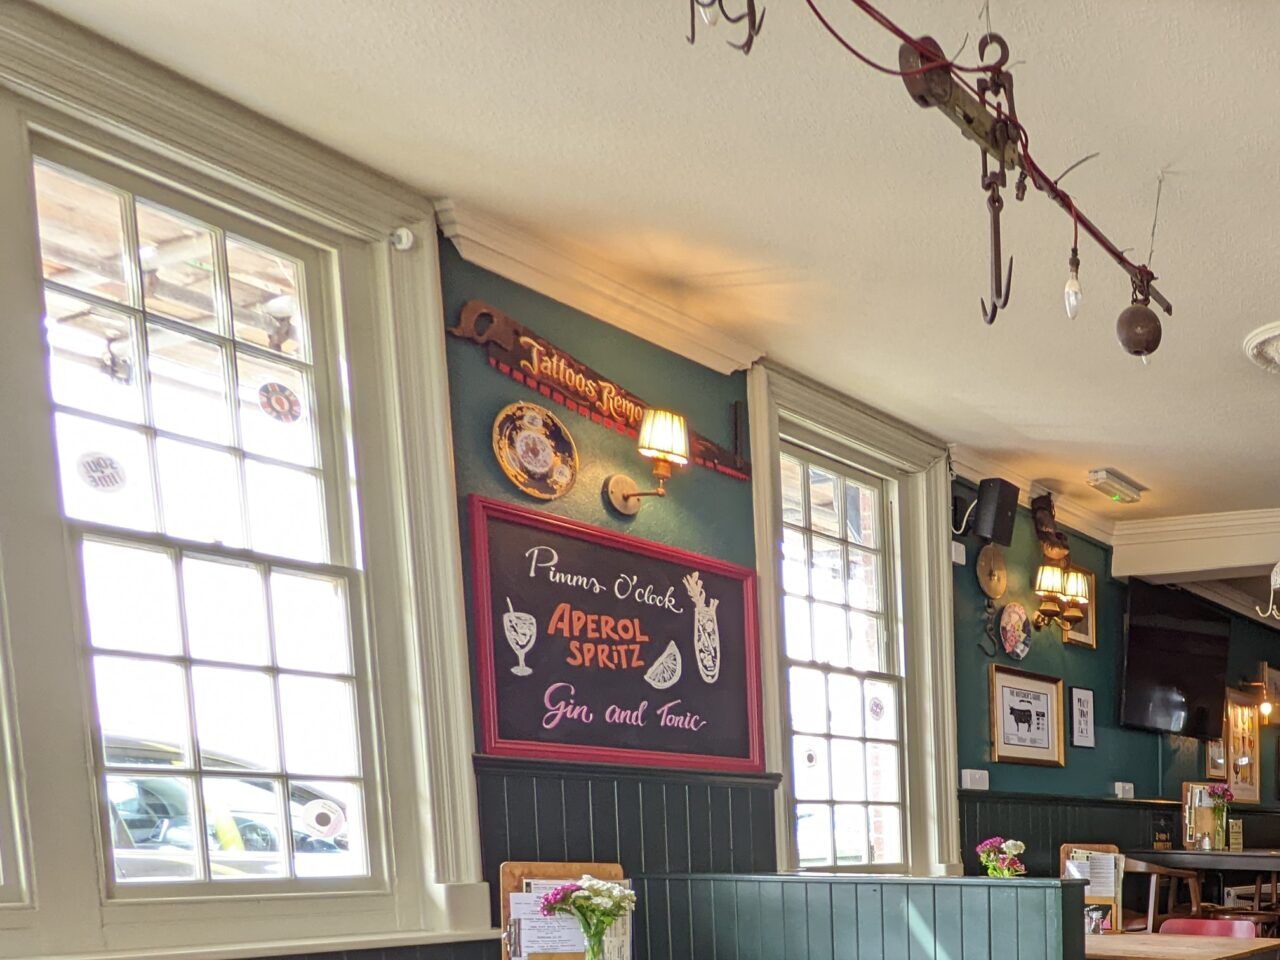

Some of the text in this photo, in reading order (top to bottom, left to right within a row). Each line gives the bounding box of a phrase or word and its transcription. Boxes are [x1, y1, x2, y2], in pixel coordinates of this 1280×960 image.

[519, 336, 644, 426] Tattoos Remo
[525, 545, 684, 614] Pimms O'clock
[547, 602, 650, 642] APEROL
[542, 682, 707, 731] Gin and Tonic
